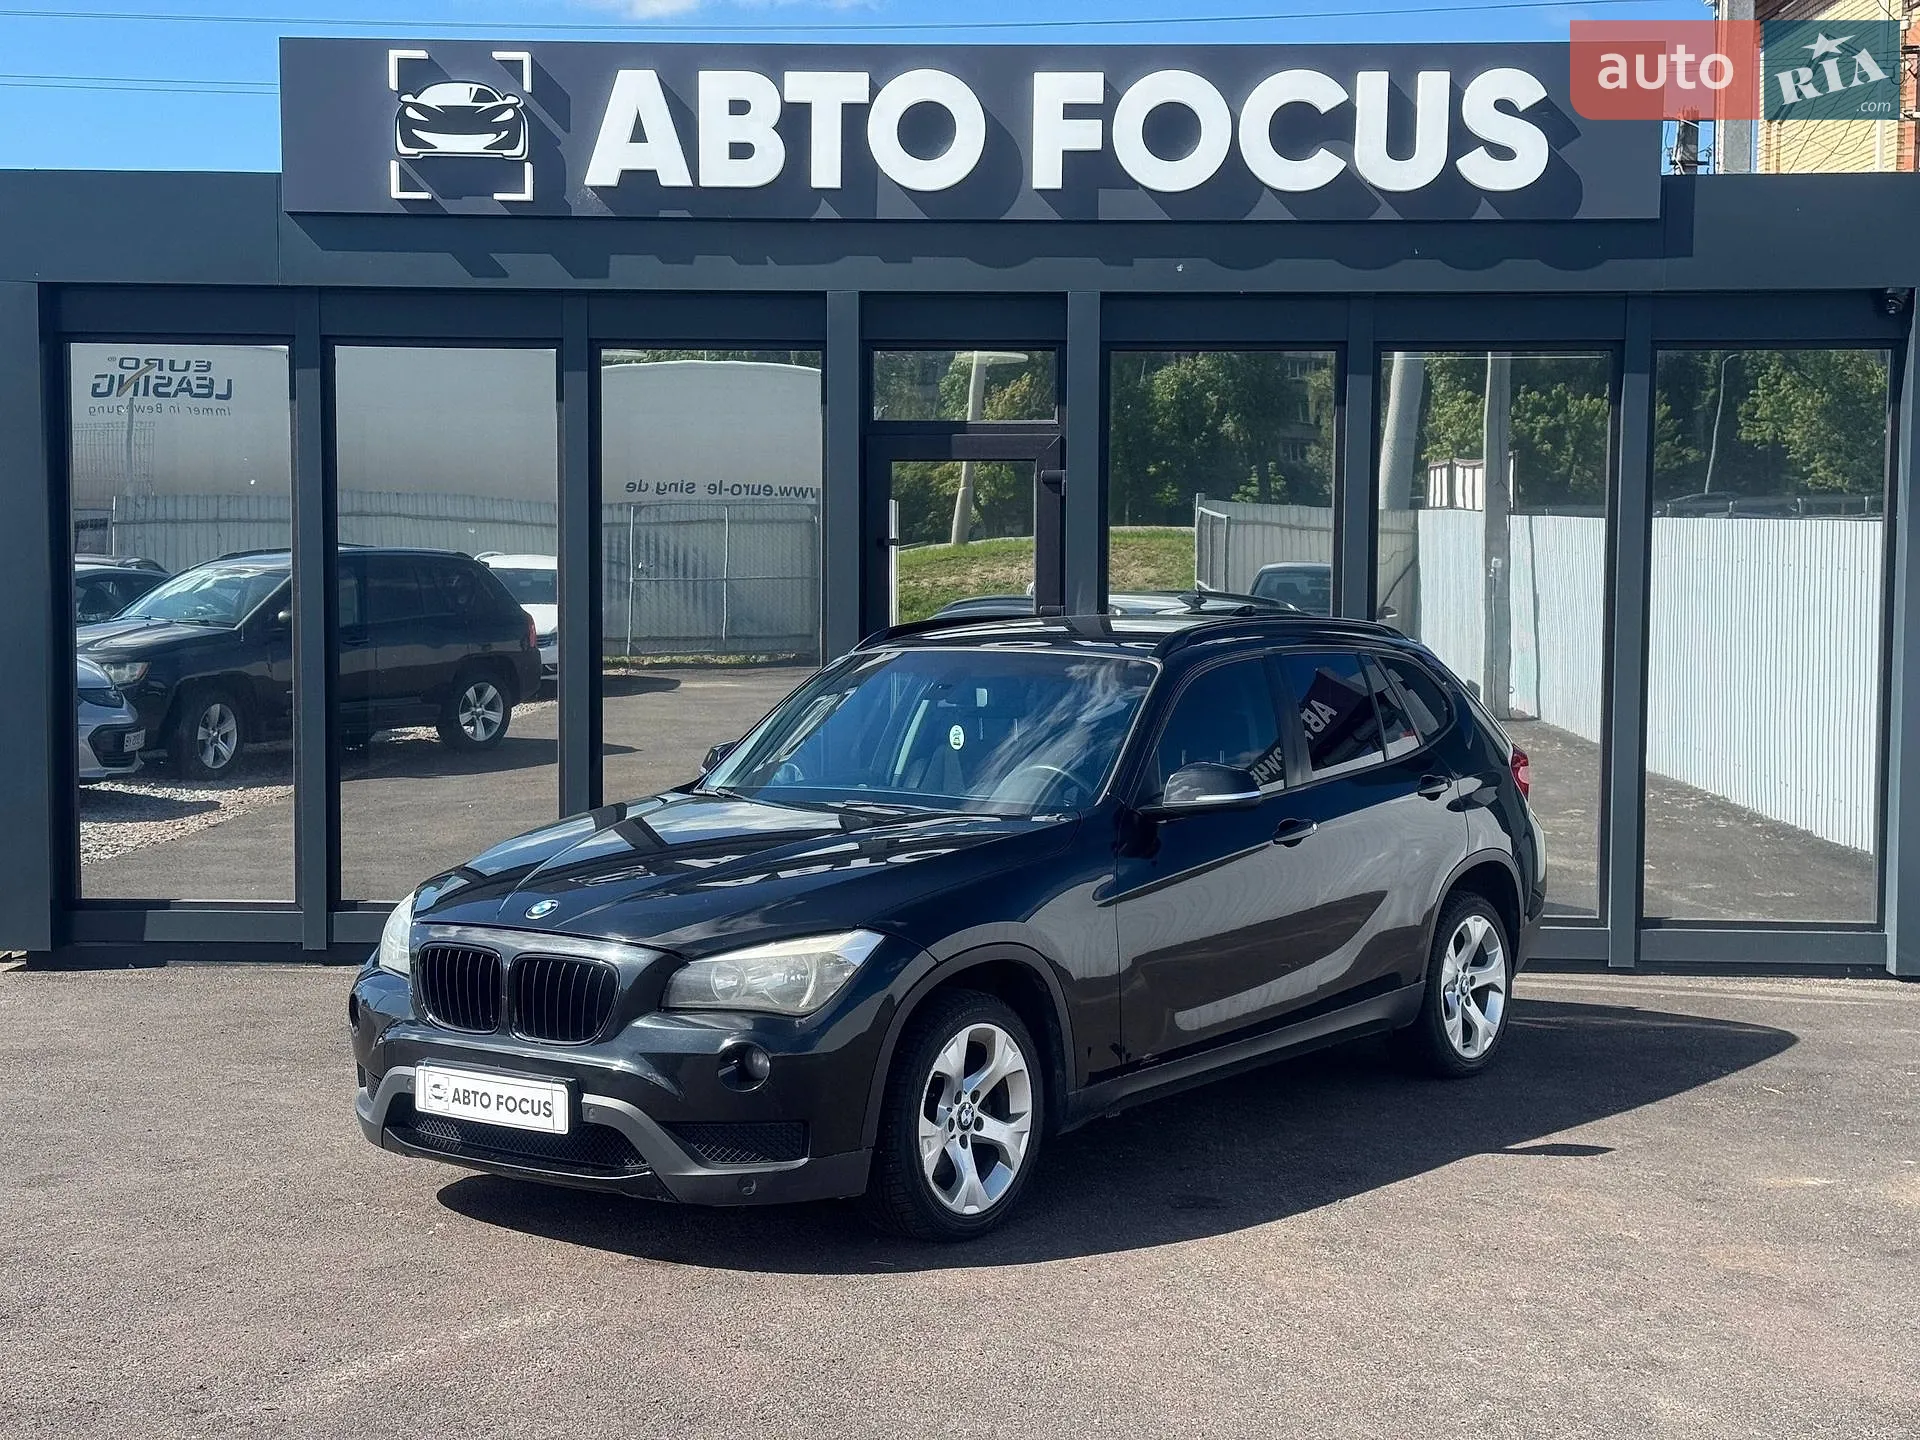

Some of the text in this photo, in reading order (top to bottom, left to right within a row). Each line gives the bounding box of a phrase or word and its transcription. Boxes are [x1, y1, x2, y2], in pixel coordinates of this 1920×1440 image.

[584, 68, 1549, 192] АВТО FOCUS
[452, 1087, 553, 1118] АВТО FOCUS
